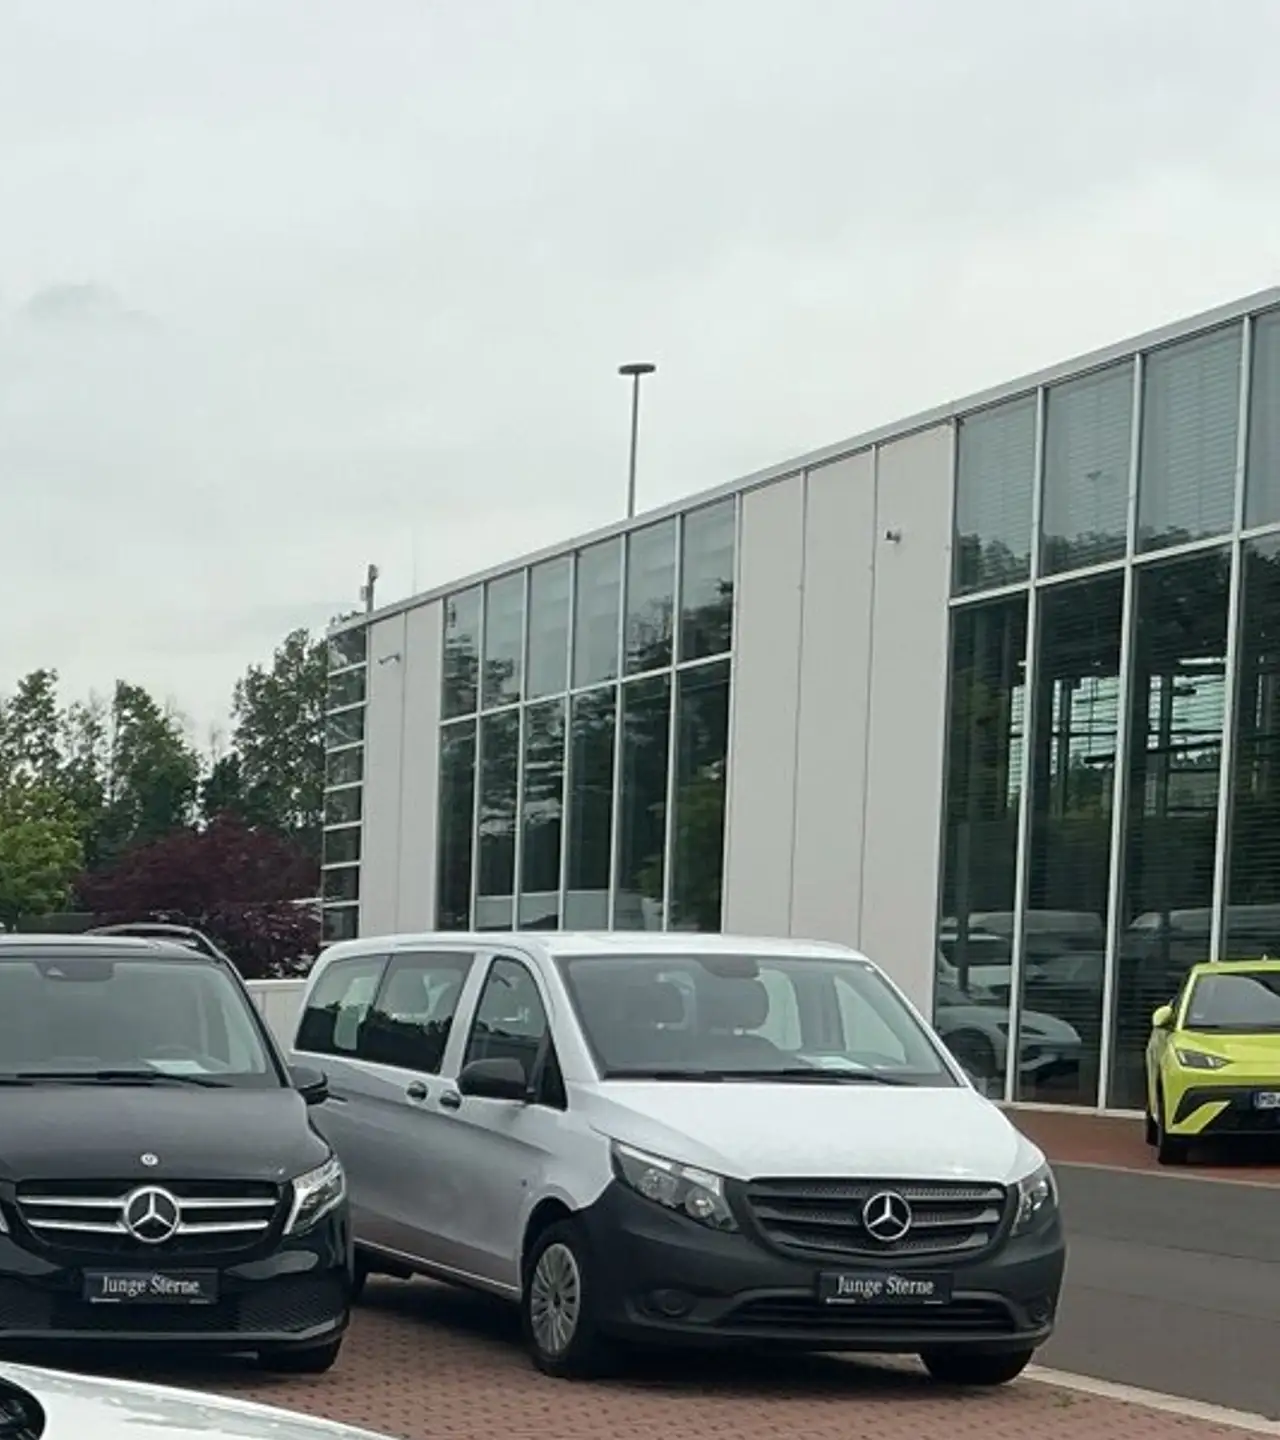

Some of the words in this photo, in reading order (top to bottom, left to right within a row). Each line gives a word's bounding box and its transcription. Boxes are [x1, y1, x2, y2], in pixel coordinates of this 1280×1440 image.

[101, 1275, 147, 1297] Junge
[149, 1273, 201, 1295] Sterne
[837, 1275, 883, 1298] Junge
[885, 1274, 935, 1295] Sterne
